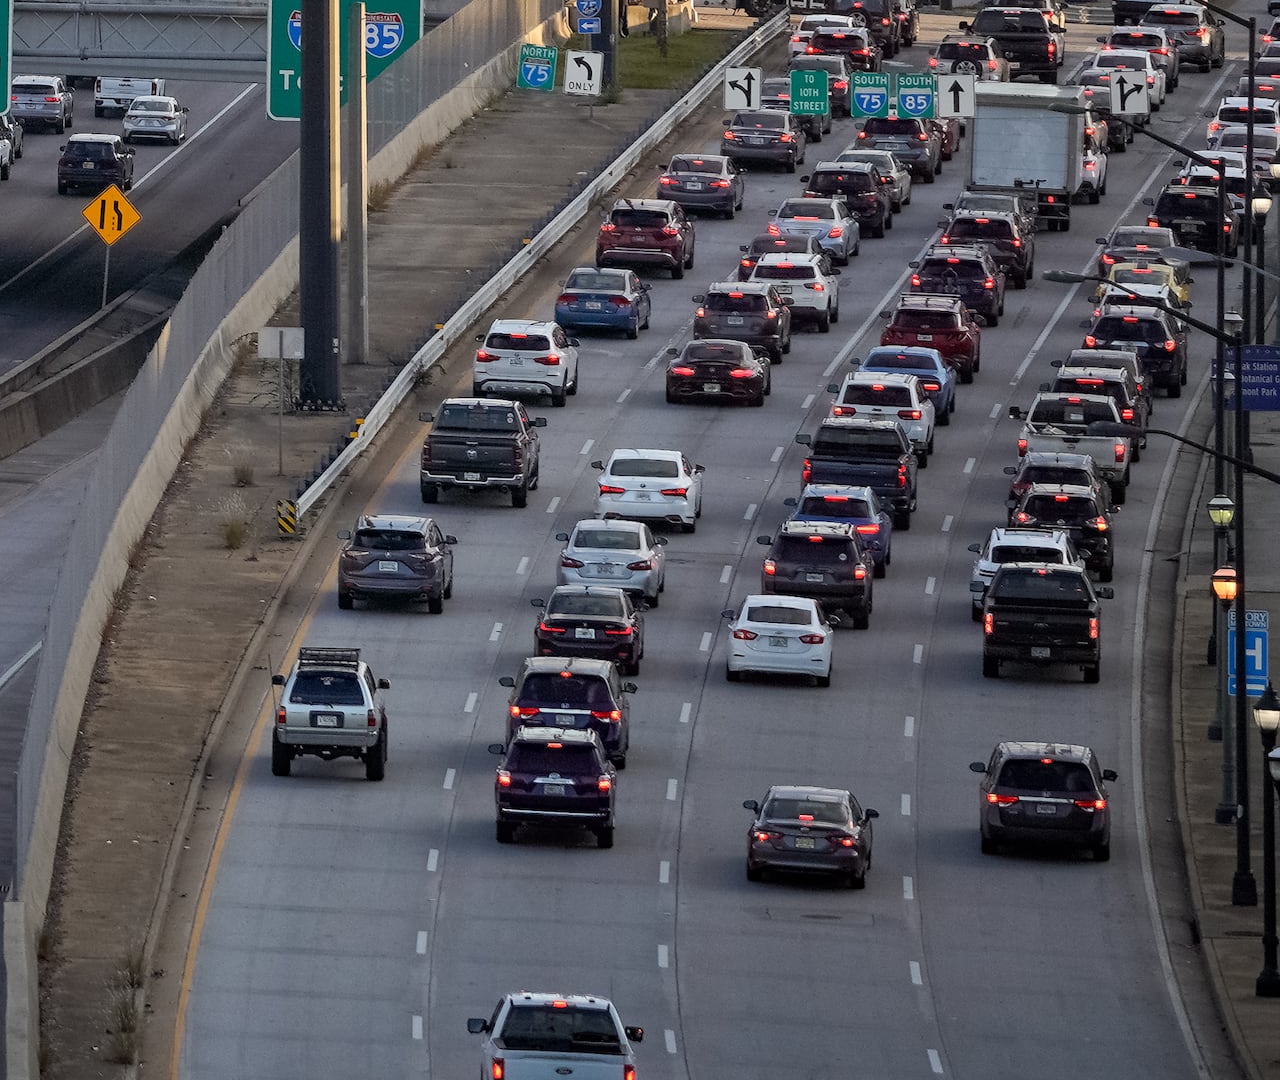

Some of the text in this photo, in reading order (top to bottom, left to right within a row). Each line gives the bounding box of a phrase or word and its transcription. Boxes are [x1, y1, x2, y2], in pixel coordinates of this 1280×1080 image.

[366, 24, 400, 49] 85
[522, 47, 555, 59] NORTH
[525, 64, 549, 82] 75
[804, 74, 815, 84] TO
[854, 75, 888, 85] SOUTH
[898, 76, 933, 86] SOUTH
[568, 81, 594, 91] ONLY
[799, 87, 819, 97] 10TH
[793, 101, 826, 111] STREET
[860, 94, 881, 109] 75
[905, 94, 928, 109] 85
[1252, 362, 1278, 371] Station
[1261, 387, 1278, 396] Park
[1230, 612, 1266, 621] EORY
